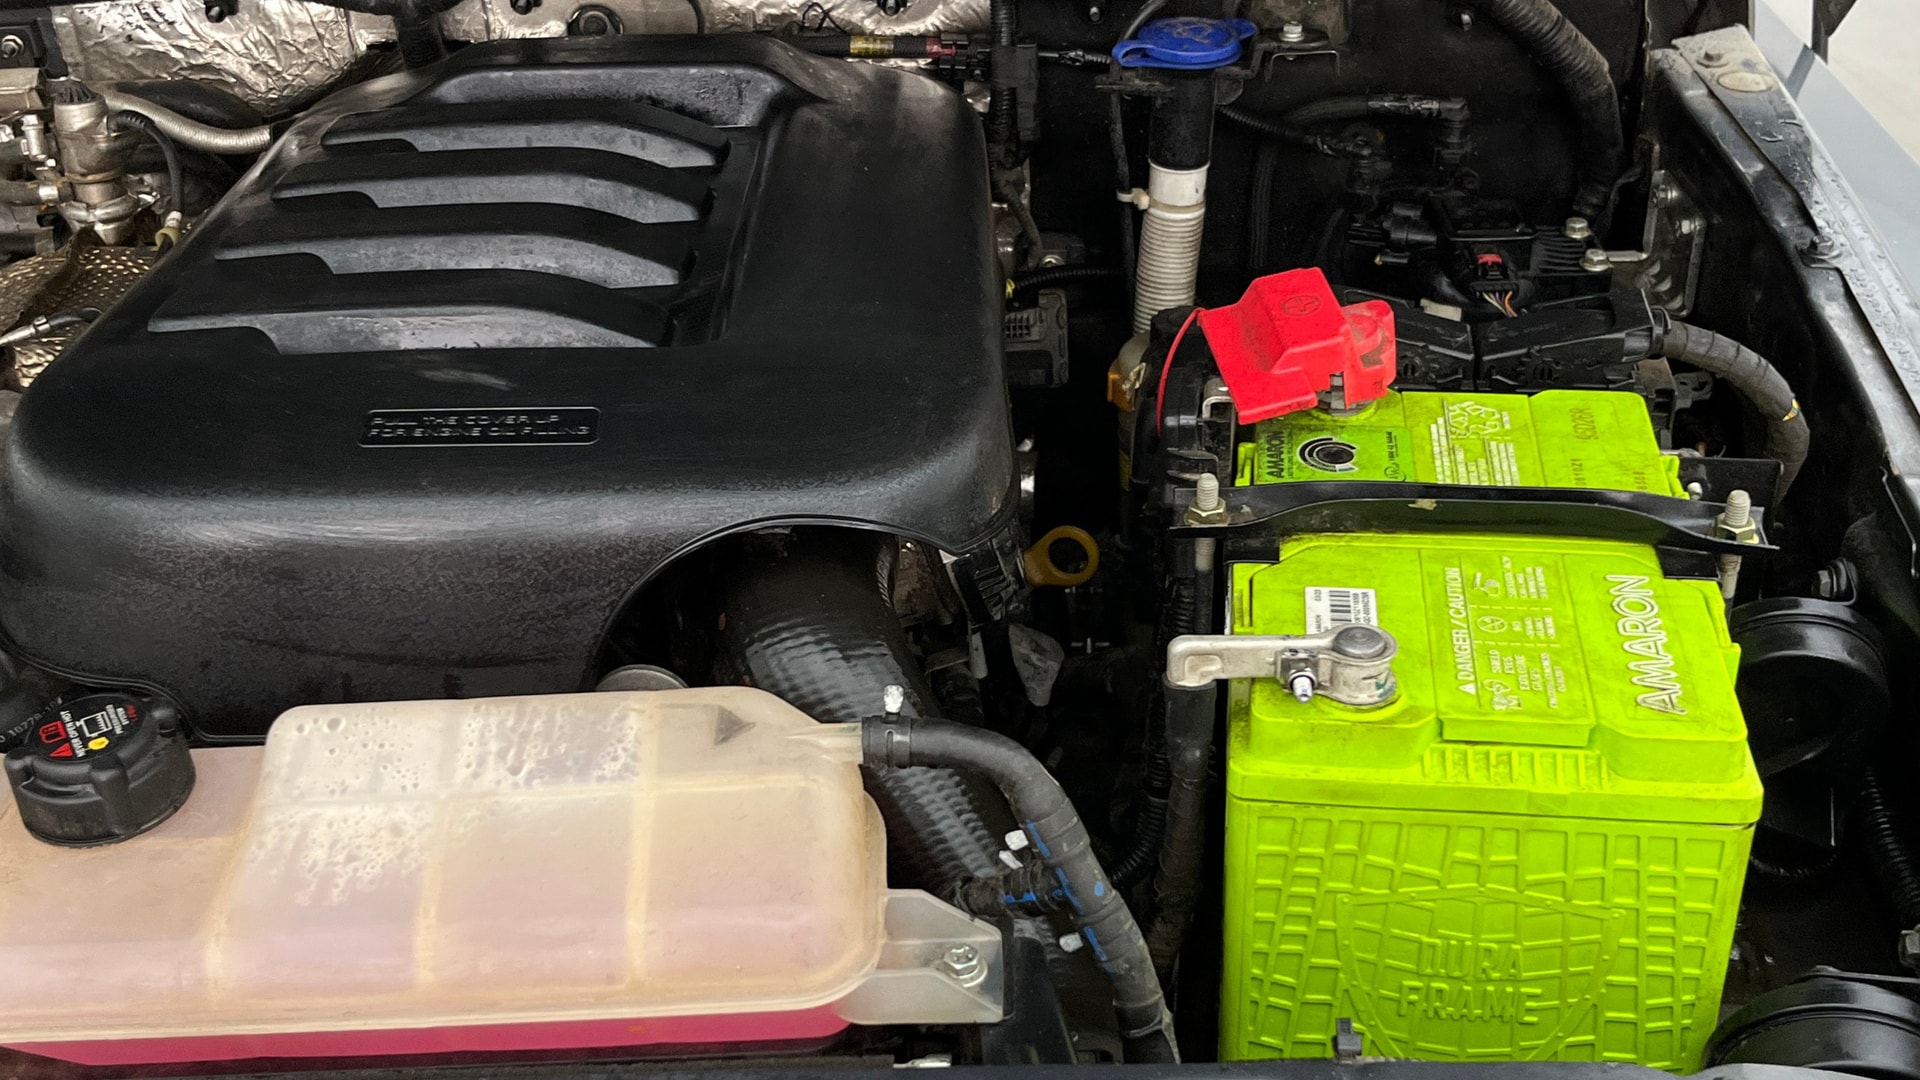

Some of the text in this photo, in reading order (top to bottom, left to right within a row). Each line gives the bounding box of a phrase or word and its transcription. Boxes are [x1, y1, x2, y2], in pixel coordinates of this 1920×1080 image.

[367, 426, 590, 438] FOR ENGINE OIL FILLING
[371, 414, 561, 426] PULL THE COVER UP
[1266, 430, 1285, 479] AMARON
[1444, 567, 1467, 618] CAUTION
[1451, 629, 1475, 681] DANGER
[1605, 574, 1688, 715] AMARON
[60, 710, 73, 723] HOT
[1418, 937, 1523, 979] DURA
[1397, 980, 1543, 1024] FRAME
